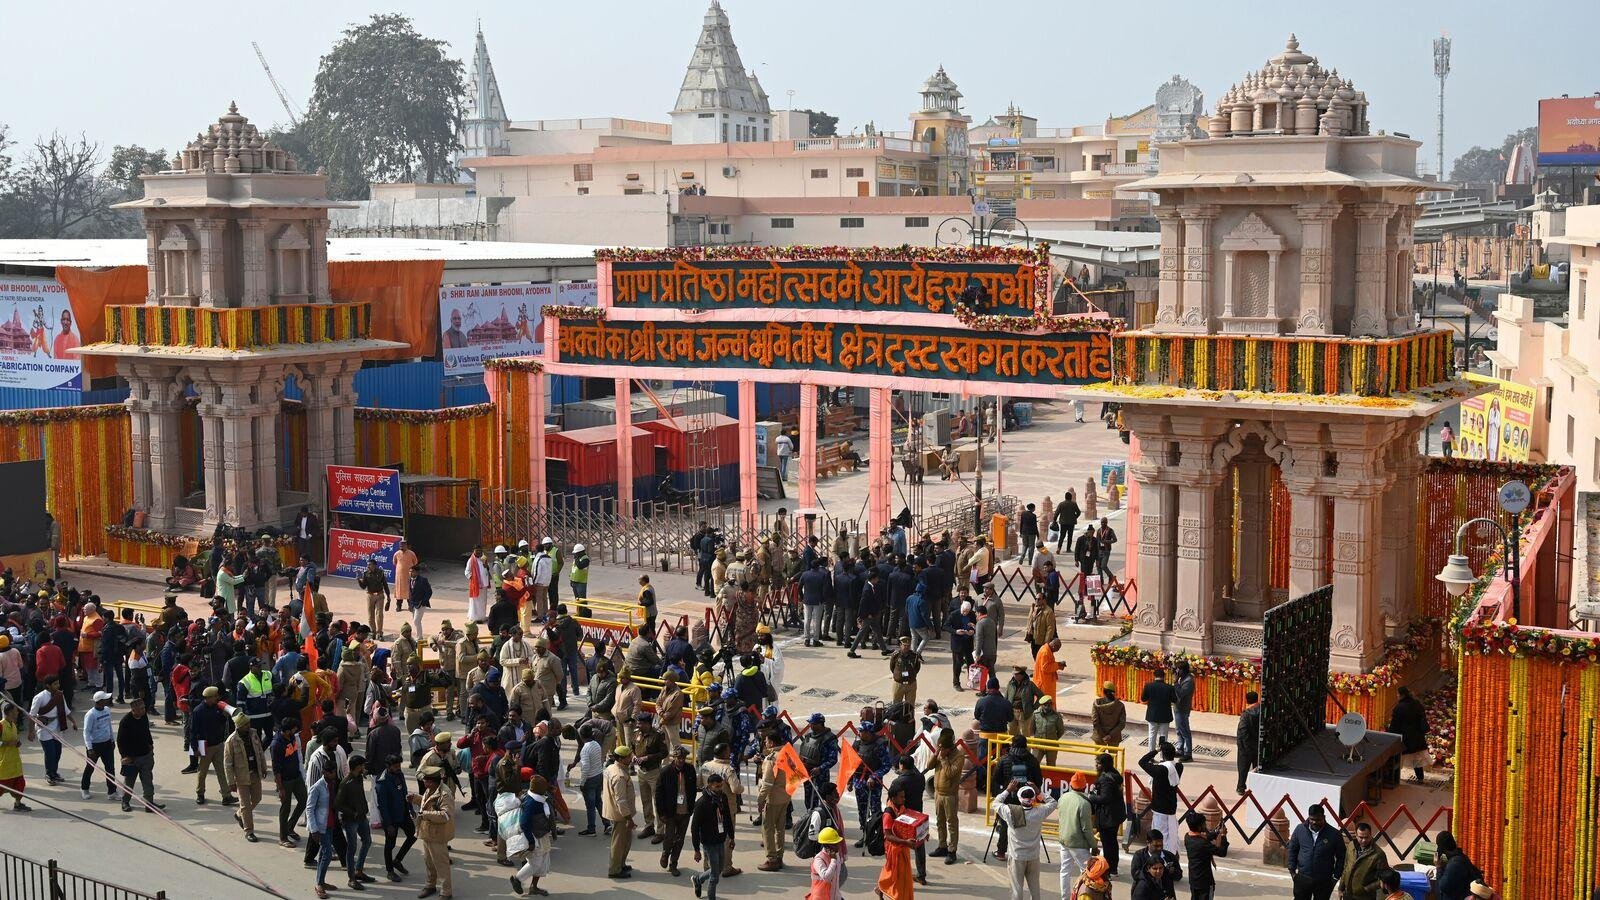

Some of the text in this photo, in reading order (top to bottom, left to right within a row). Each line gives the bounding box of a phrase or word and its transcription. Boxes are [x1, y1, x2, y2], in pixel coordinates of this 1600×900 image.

[613, 270, 658, 302] प्राण
[658, 260, 735, 302] प्रतिष्ठा
[450, 290, 465, 298] SHRI
[467, 289, 480, 297] RAM
[481, 288, 499, 297] JANM
[526, 286, 551, 295] AYODHYA
[630, 321, 656, 362] श्री
[457, 355, 480, 363] Vishwa
[44, 364, 80, 373] COMPANY
[335, 469, 352, 484] पुलिस
[354, 473, 375, 484] सहायता
[341, 485, 387, 497] Police Help Center
[337, 533, 355, 548] पुलिस
[357, 538, 379, 549] सहायता
[341, 549, 388, 563] Police Help Center
